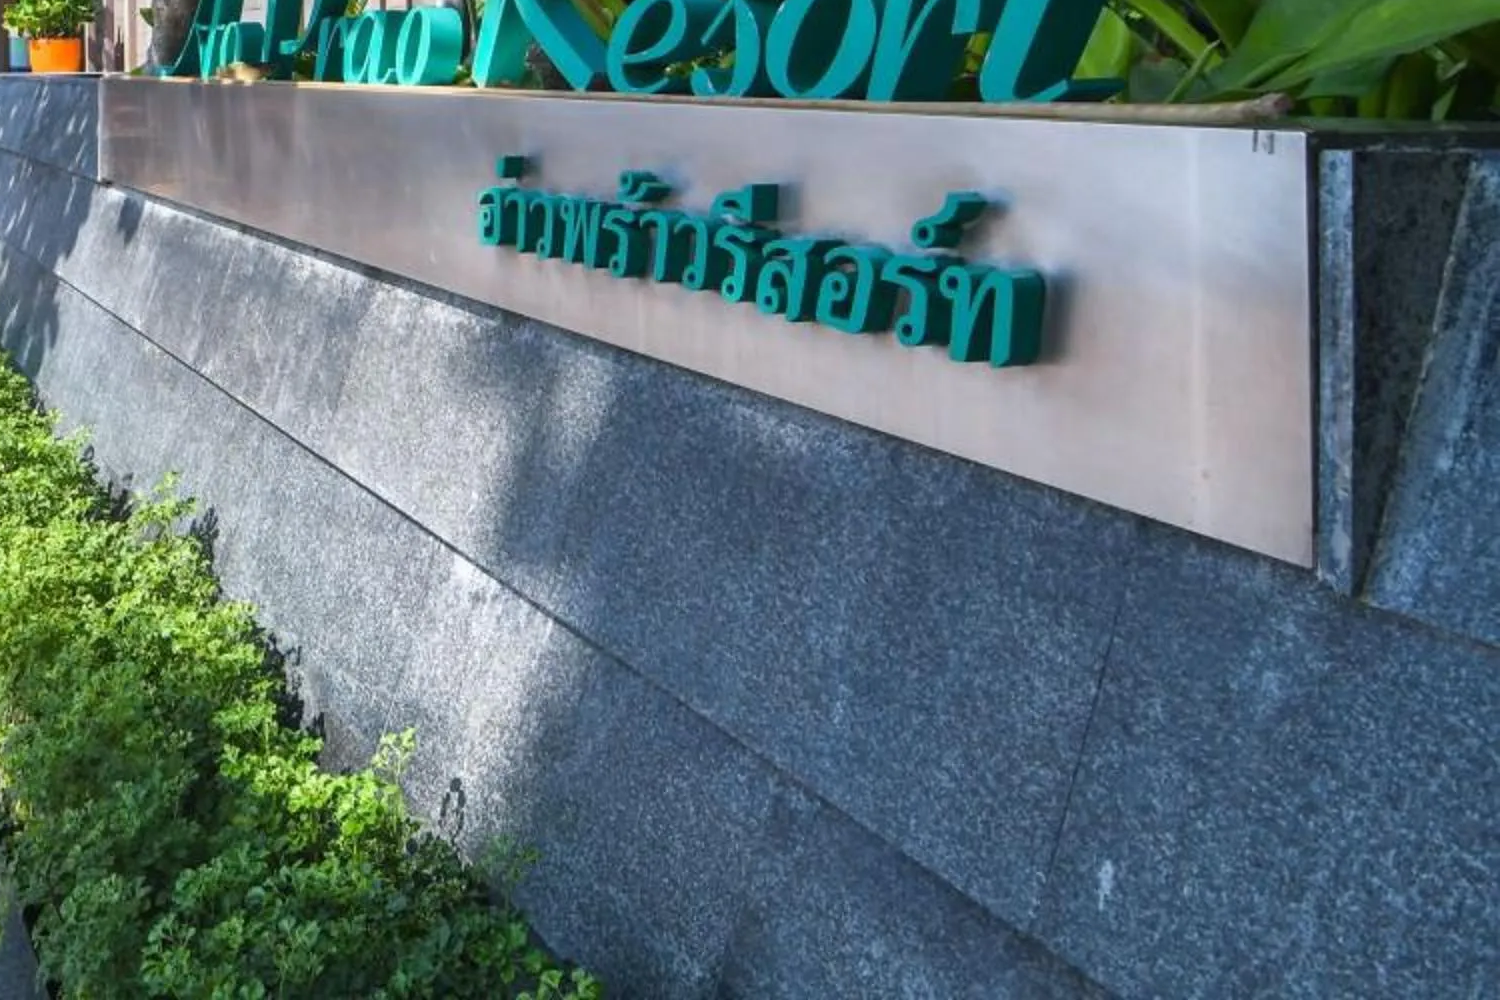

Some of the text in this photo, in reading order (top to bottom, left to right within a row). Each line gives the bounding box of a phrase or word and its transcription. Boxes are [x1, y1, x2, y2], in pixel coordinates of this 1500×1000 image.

[477, 155, 1046, 369] อ่าวพร้าวรีสอร์ท
